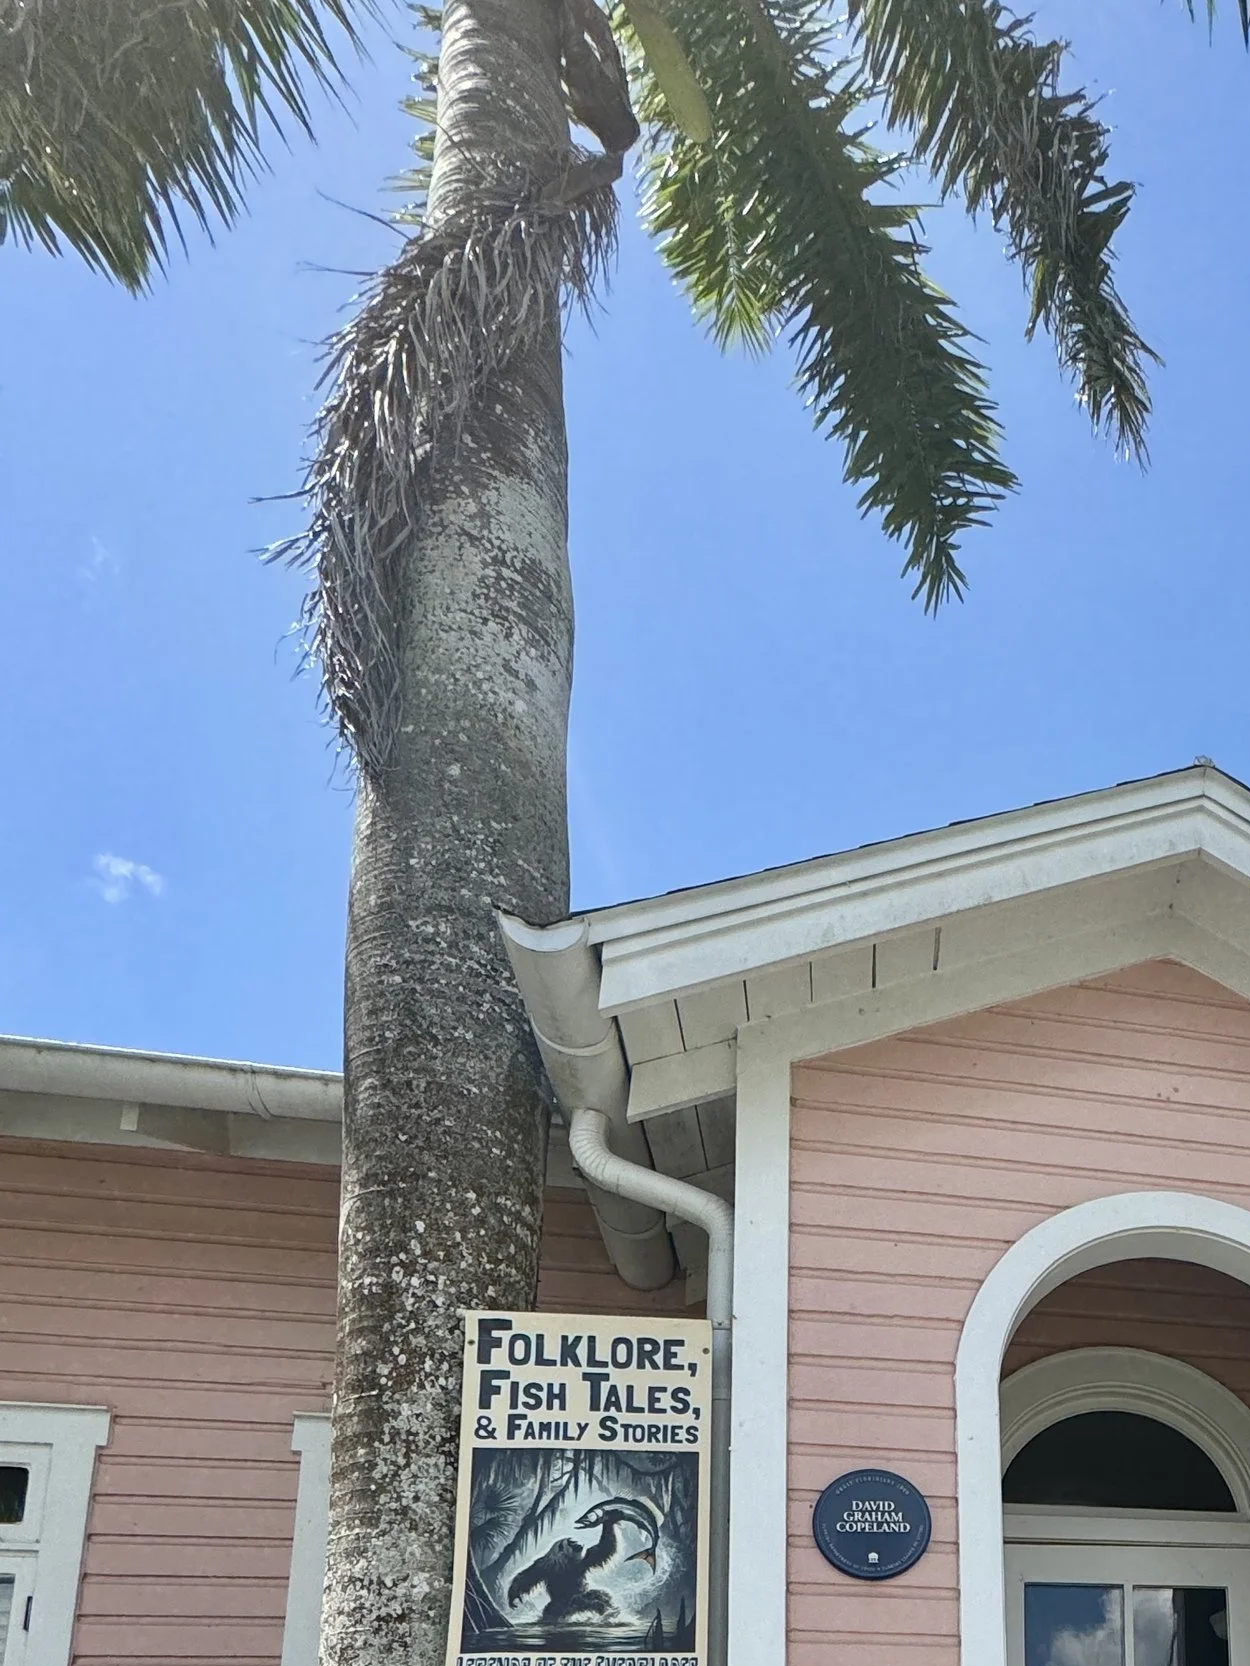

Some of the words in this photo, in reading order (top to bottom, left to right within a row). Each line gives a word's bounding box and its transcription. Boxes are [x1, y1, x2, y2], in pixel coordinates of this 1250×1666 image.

[477, 1318, 698, 1377] FOLKLORE,
[478, 1369, 566, 1411] FISH
[582, 1372, 700, 1420] TALES,
[474, 1415, 497, 1440] &
[506, 1413, 589, 1441] FAMILY
[598, 1415, 699, 1444] STORIES
[852, 1500, 895, 1511] DAVID
[836, 1522, 911, 1533] COPELAND
[843, 1512, 903, 1522] GRAHAM
